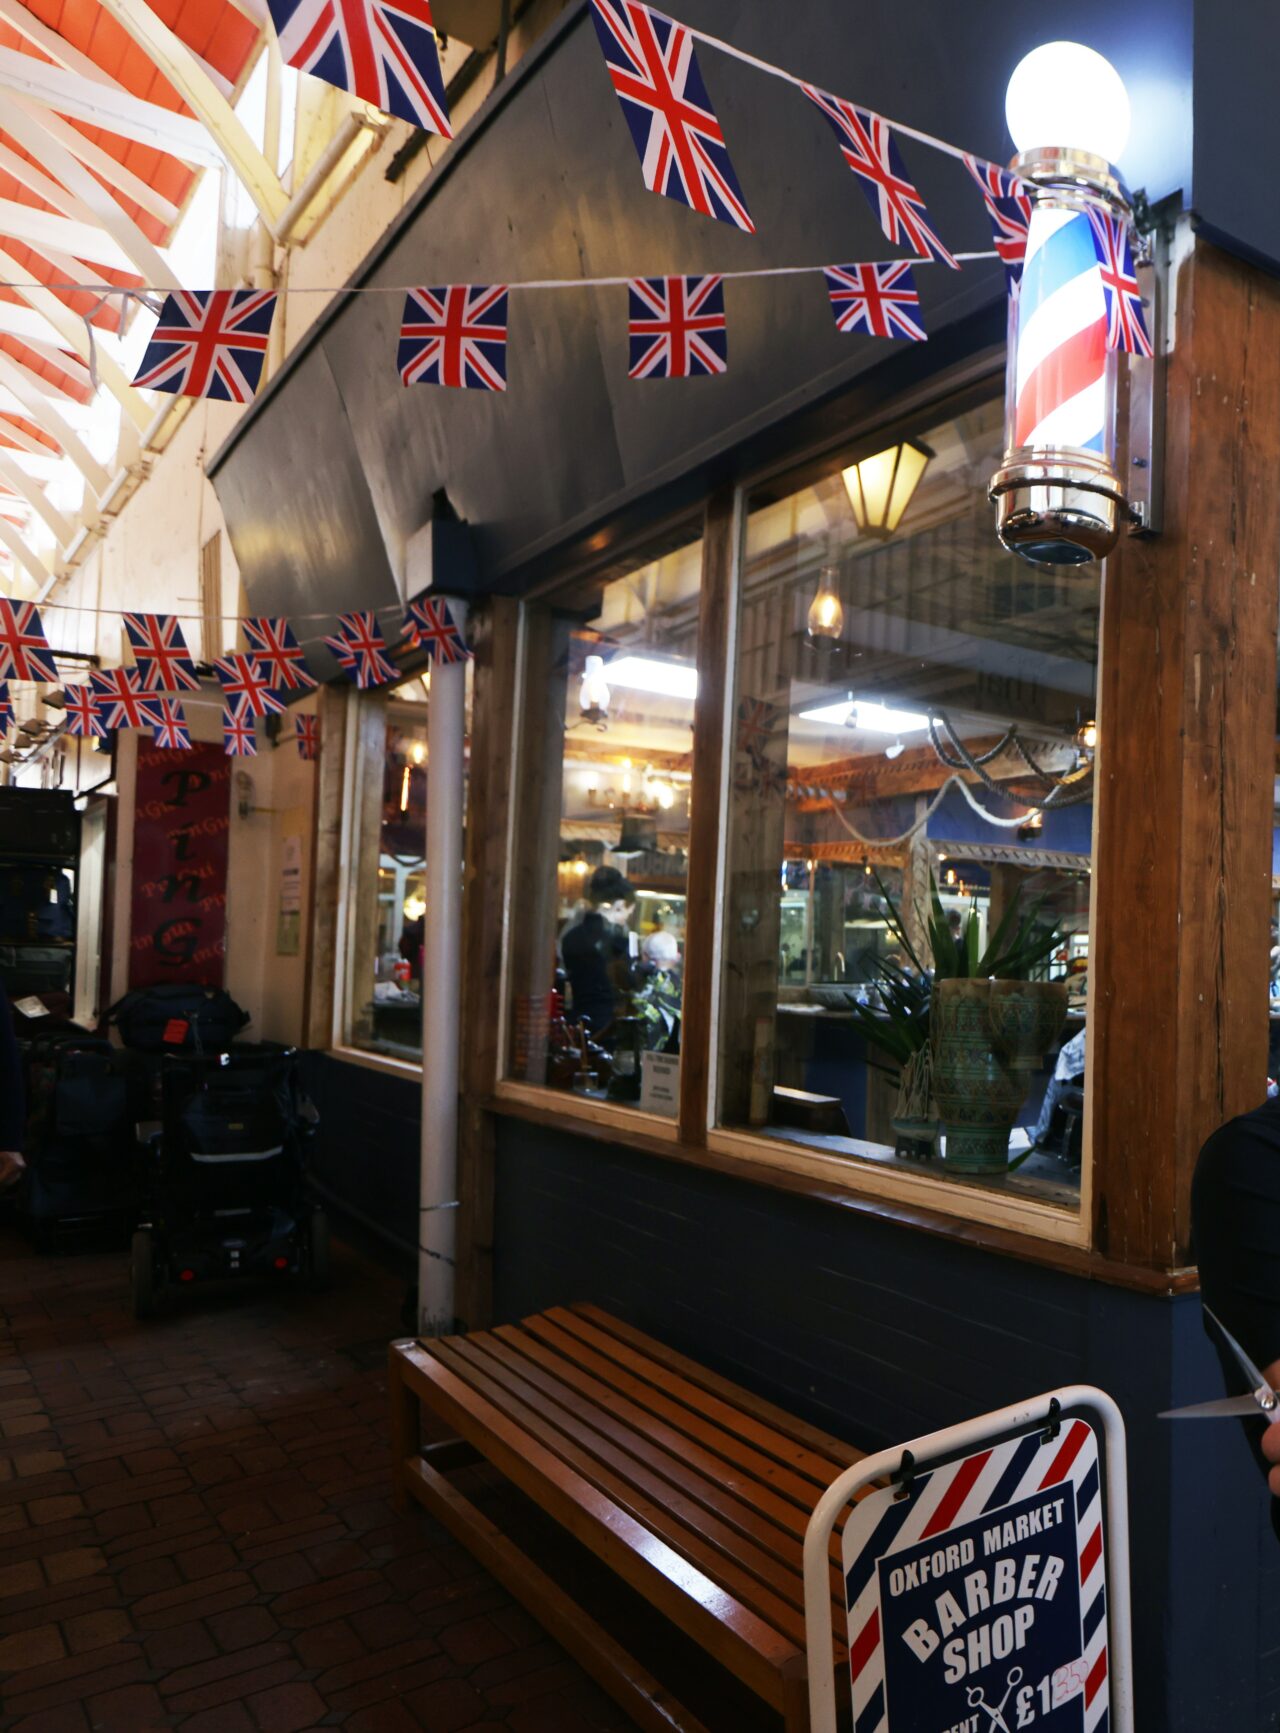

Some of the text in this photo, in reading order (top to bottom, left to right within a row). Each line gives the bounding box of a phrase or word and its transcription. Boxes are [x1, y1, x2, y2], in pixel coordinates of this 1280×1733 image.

[888, 1497, 1065, 1598] OXFORD MARKET
[901, 1554, 1065, 1664] BARBER
[943, 1604, 1036, 1685] SHOP
